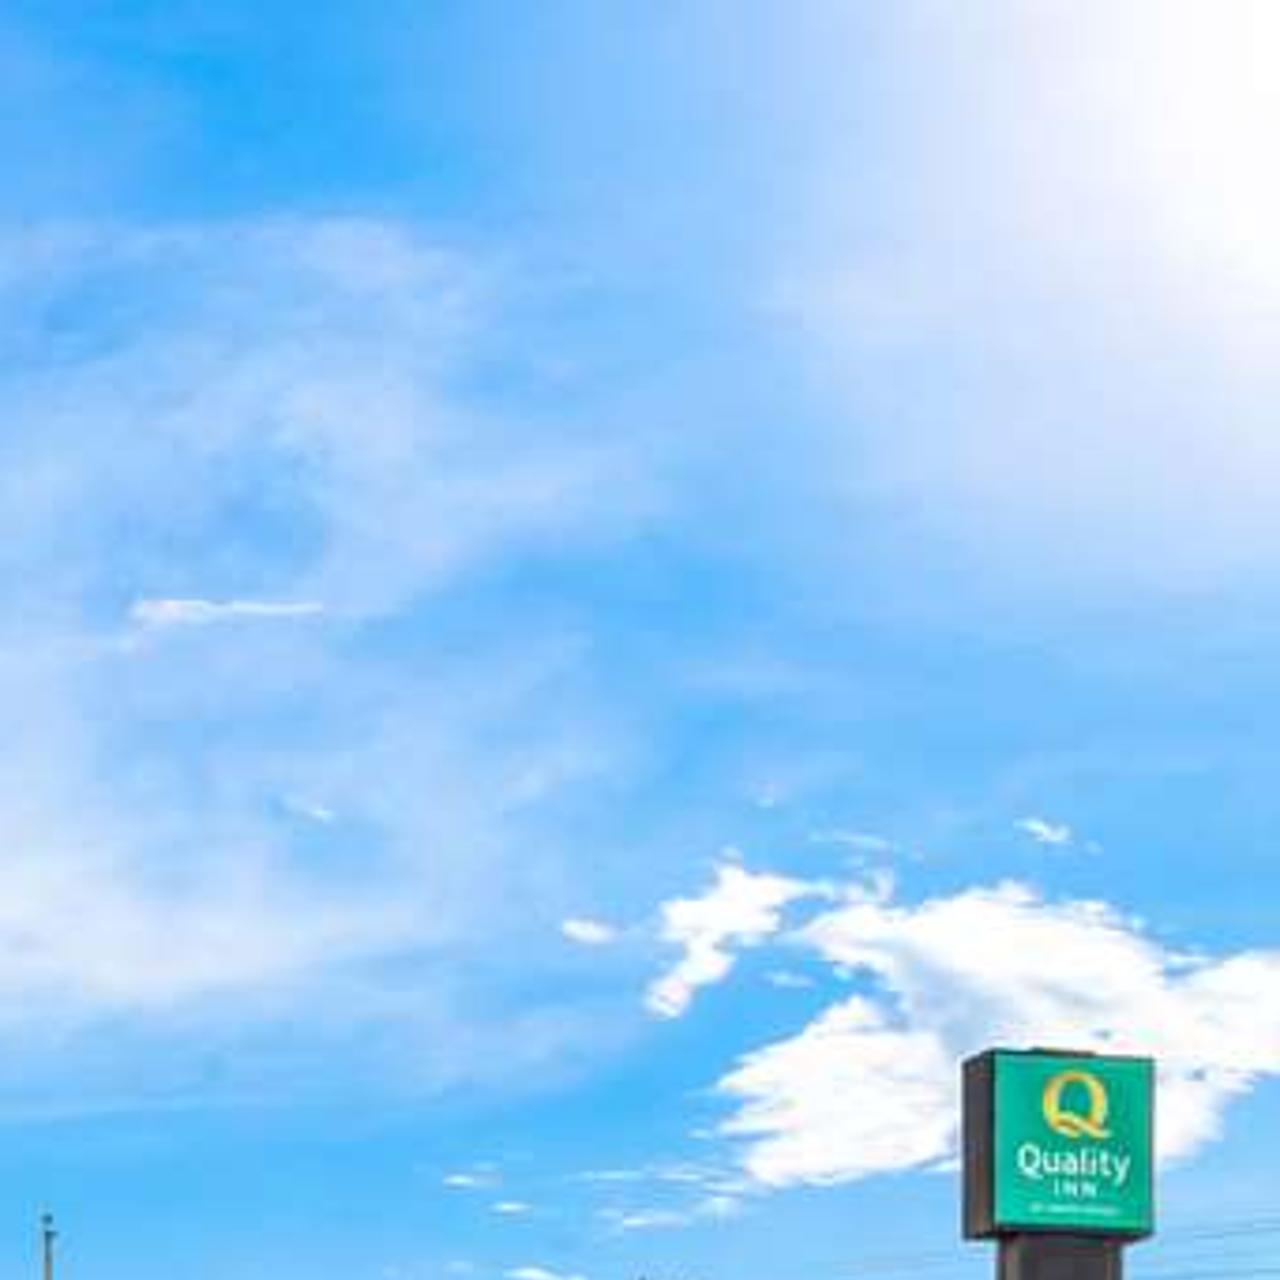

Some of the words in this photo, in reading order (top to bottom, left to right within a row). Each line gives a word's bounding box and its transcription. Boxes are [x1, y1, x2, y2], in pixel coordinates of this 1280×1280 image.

[1043, 1071, 1111, 1138] Q
[1017, 1143, 1130, 1186] Quality
[1054, 1179, 1097, 1197] INN
